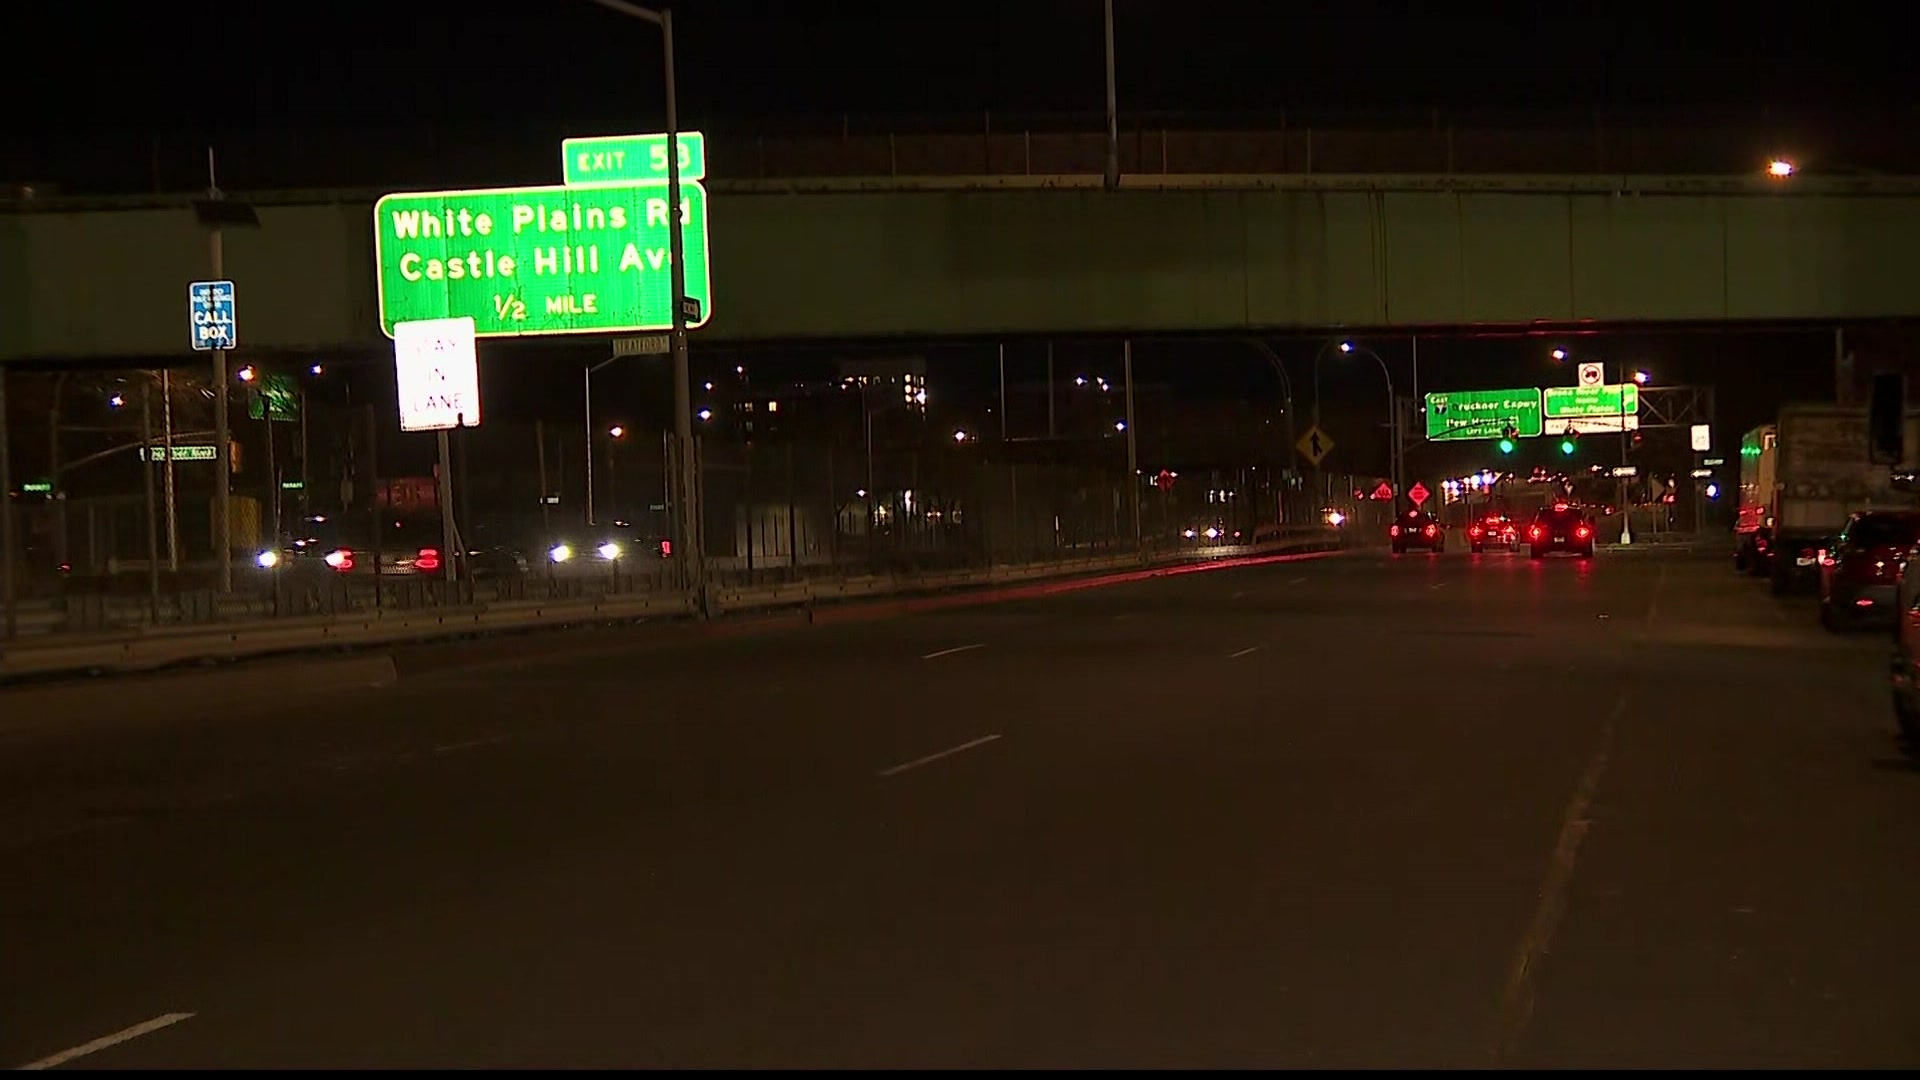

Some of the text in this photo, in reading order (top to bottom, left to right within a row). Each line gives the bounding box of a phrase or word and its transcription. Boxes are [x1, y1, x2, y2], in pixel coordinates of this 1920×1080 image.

[577, 151, 625, 172] EXIT
[391, 207, 493, 239] White
[511, 202, 627, 234] Plains
[399, 243, 678, 282] Castle Hill Av
[545, 294, 598, 315] MILE
[194, 310, 233, 325] CALL
[198, 325, 230, 342] BOX
[413, 392, 464, 412] LANE
